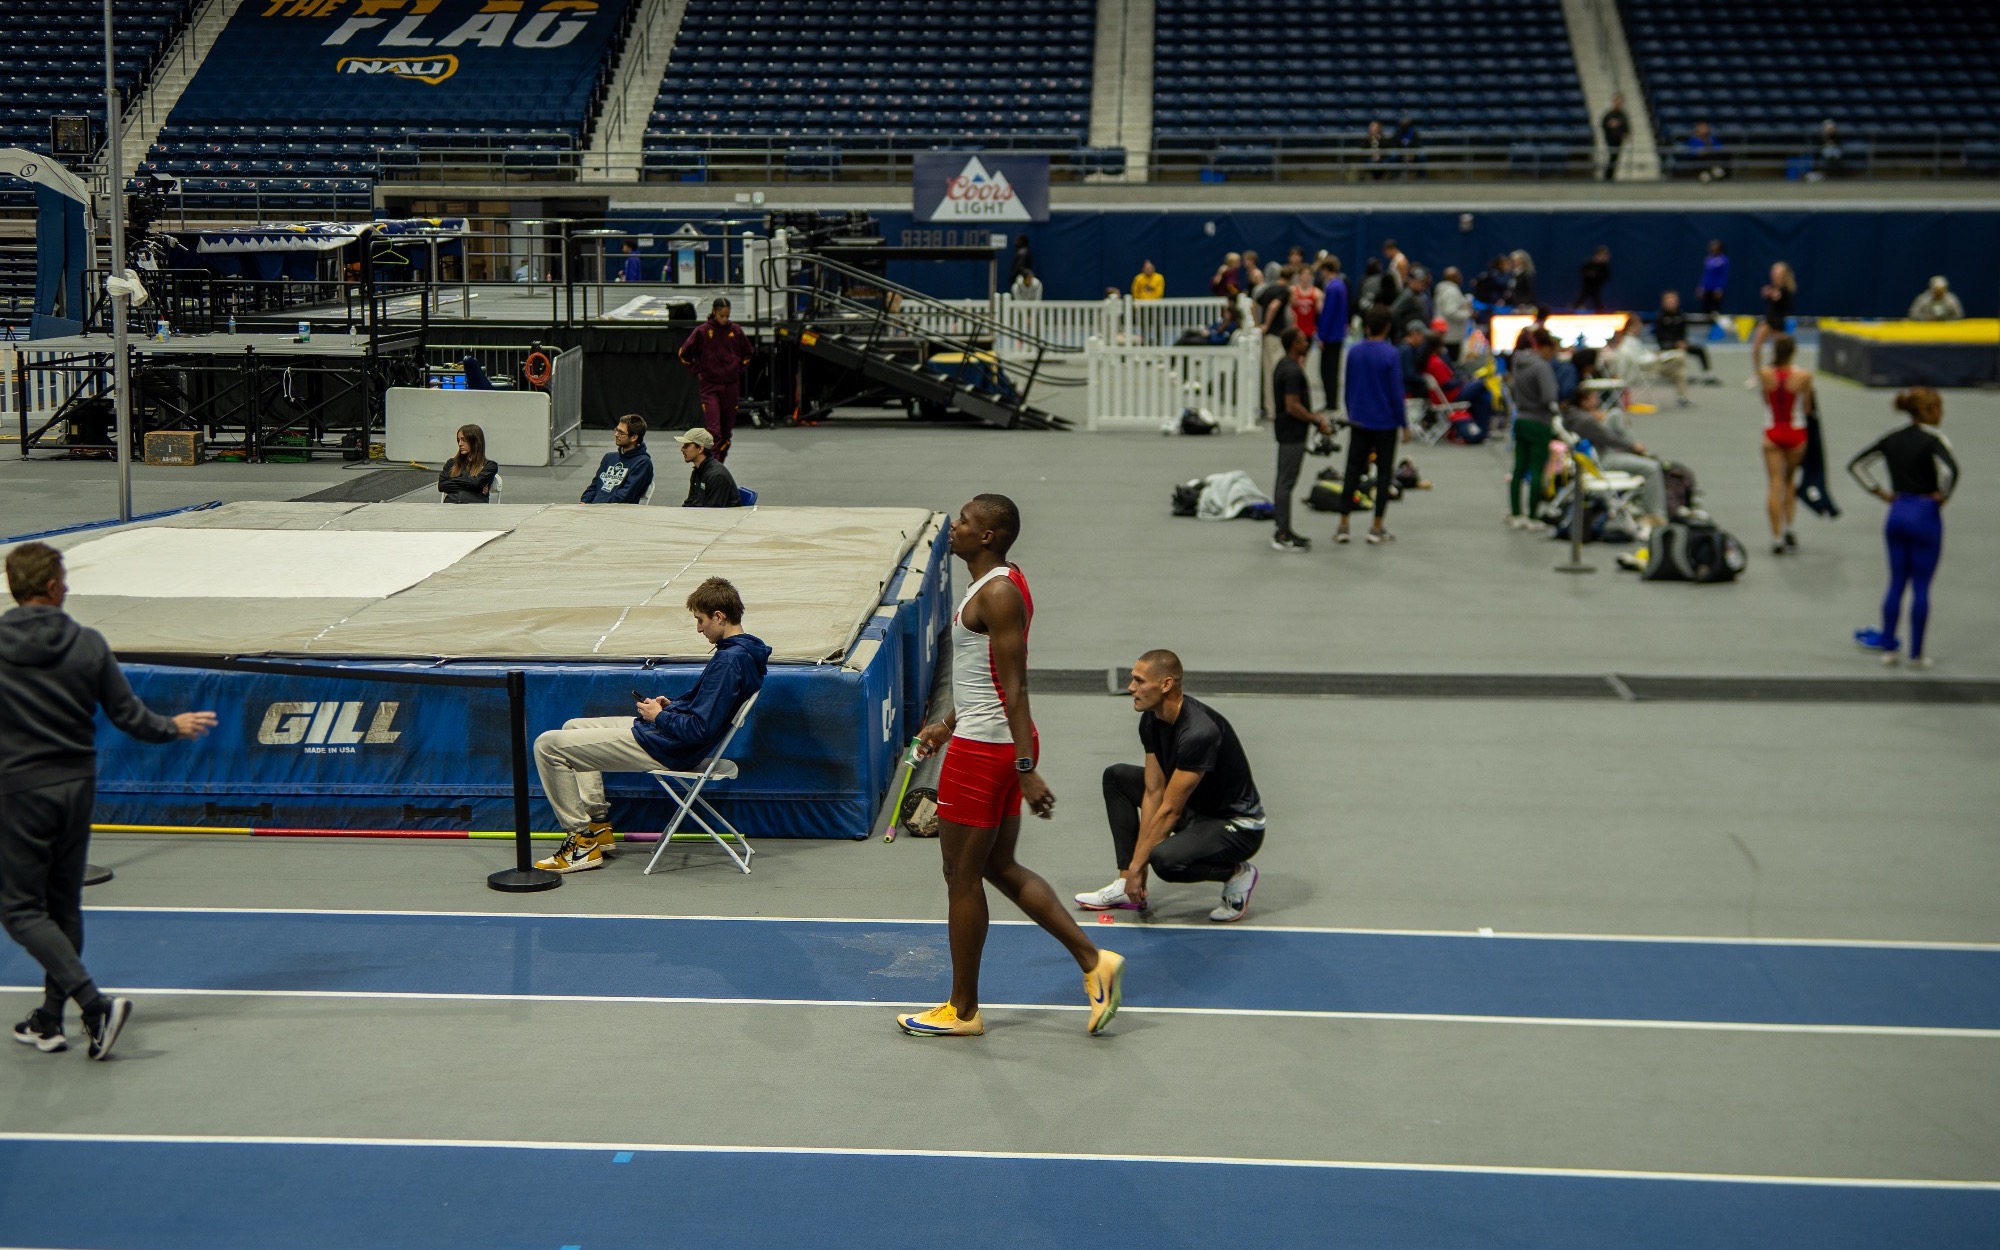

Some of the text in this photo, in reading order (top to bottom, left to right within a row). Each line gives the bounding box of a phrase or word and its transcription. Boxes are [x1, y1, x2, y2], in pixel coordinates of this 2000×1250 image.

[260, 0, 345, 17] THE
[321, 0, 600, 48] FLAG
[347, 60, 446, 75] NAU
[947, 175, 1013, 201] Coors
[955, 201, 1005, 215] LIGHT
[257, 701, 402, 745] GILL
[339, 746, 356, 754] USA
